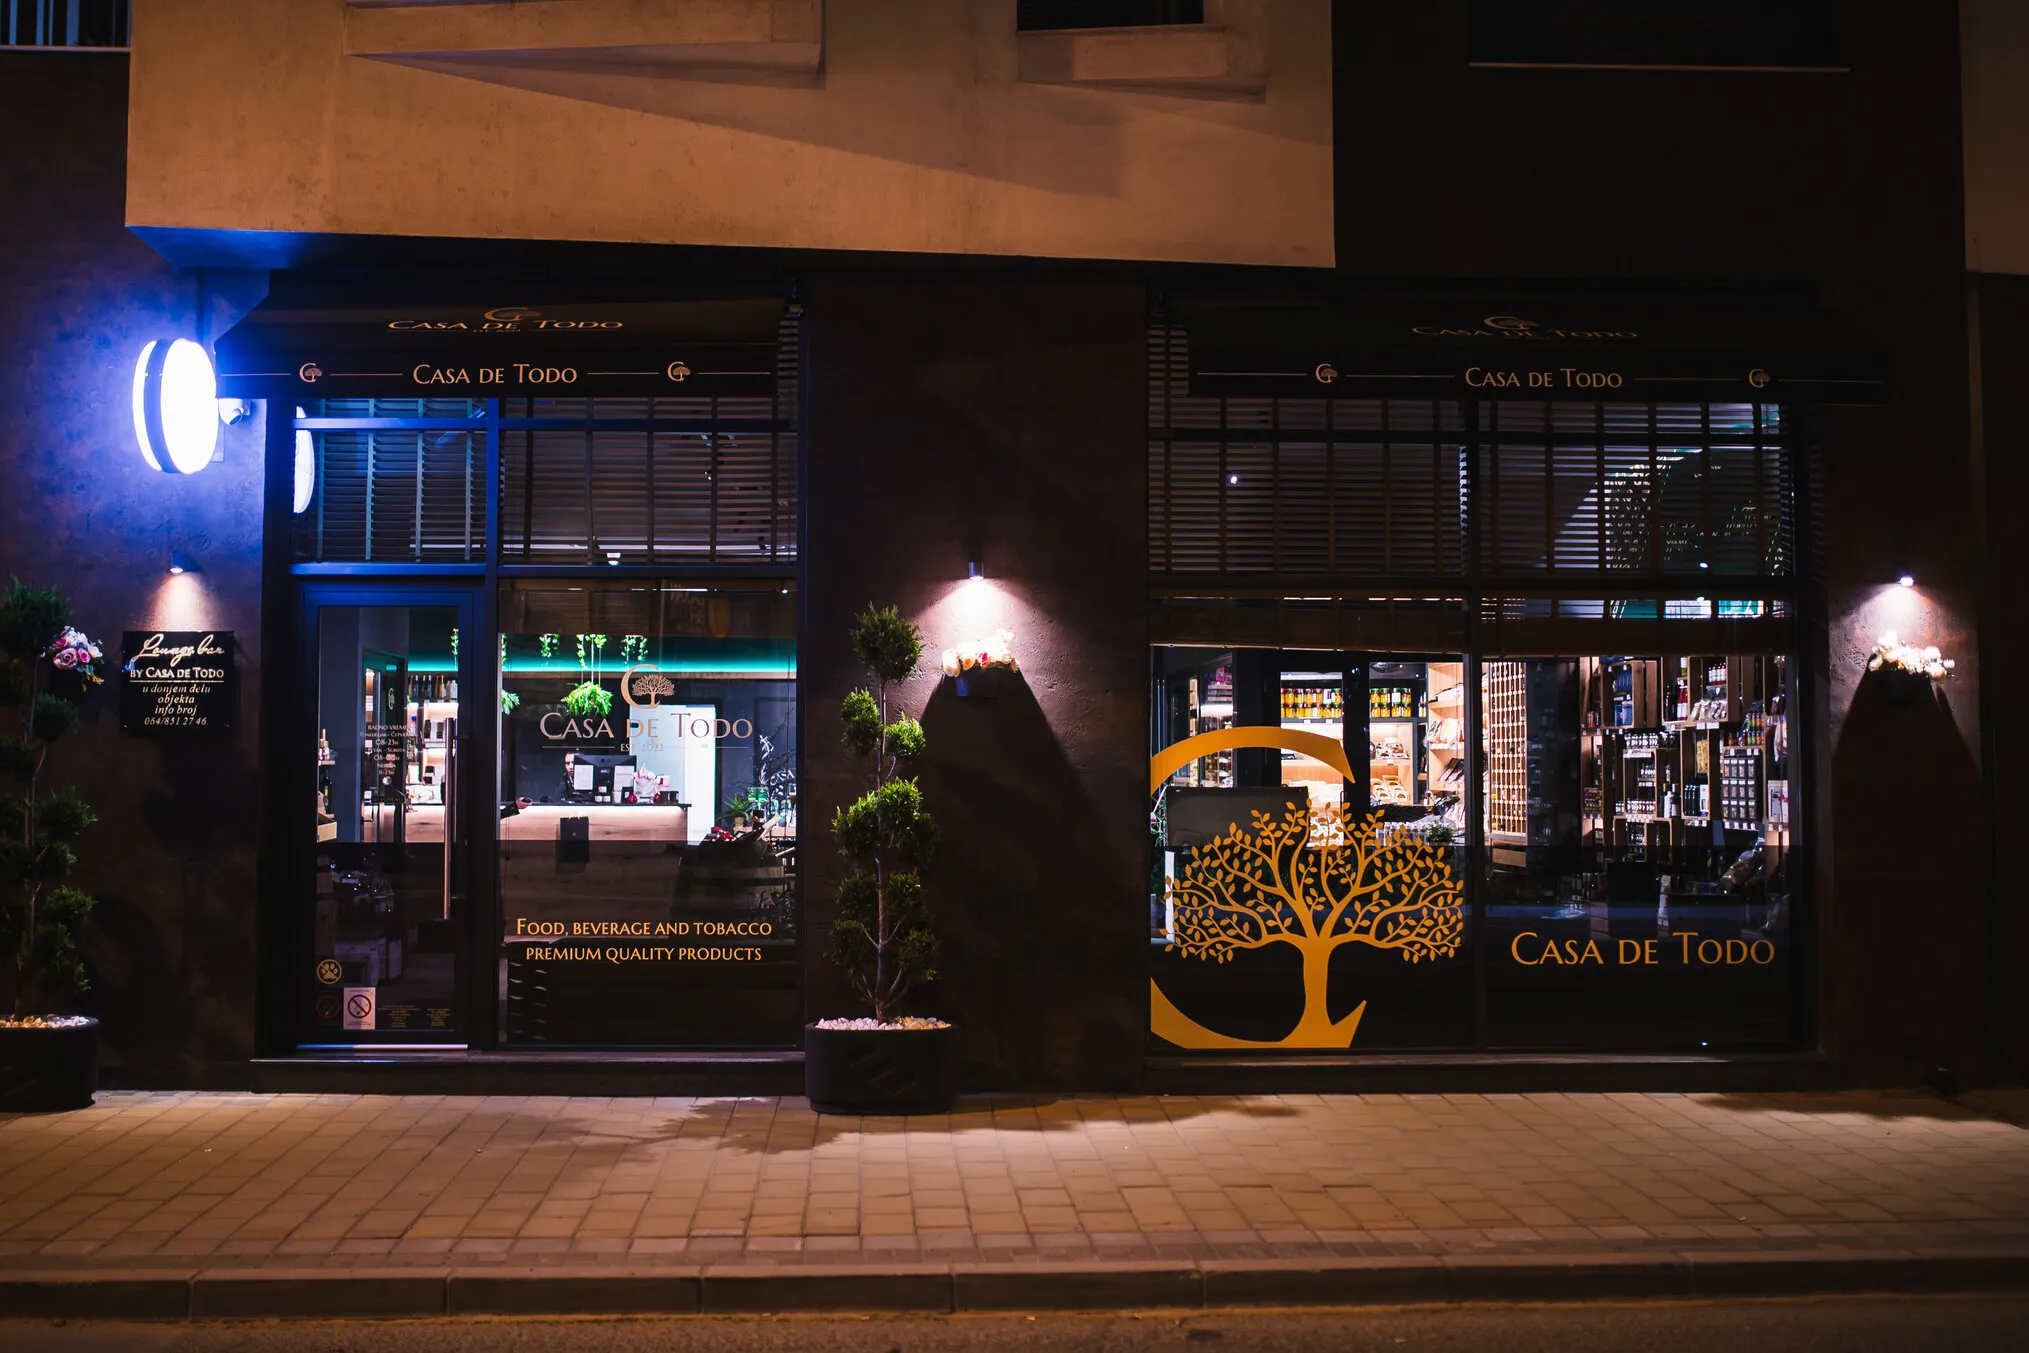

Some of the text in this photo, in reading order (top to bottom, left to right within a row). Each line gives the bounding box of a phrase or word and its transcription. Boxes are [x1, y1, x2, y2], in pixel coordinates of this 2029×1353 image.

[388, 320, 468, 329] CASA
[534, 319, 623, 329] TODO
[1411, 326, 1494, 336] CASA
[412, 364, 577, 384] CASA DE TODO
[1465, 367, 1623, 388] CASA DE TODO
[131, 633, 225, 667] Lounge bar
[130, 666, 224, 678] BY CASA DE TODO
[150, 684, 187, 695] donjem
[189, 683, 211, 693] delu
[157, 694, 195, 707] objekta
[154, 703, 197, 716] info broj
[183, 717, 194, 726] 27
[196, 717, 207, 726] 46
[539, 712, 753, 740] CASA DE TODO
[516, 918, 772, 936] FOOD, BEVERAGE AND TOBACCO
[526, 947, 762, 964] PREMIUM QUALITY PRODUCTS
[1511, 932, 1775, 965] CASA DE TODO
